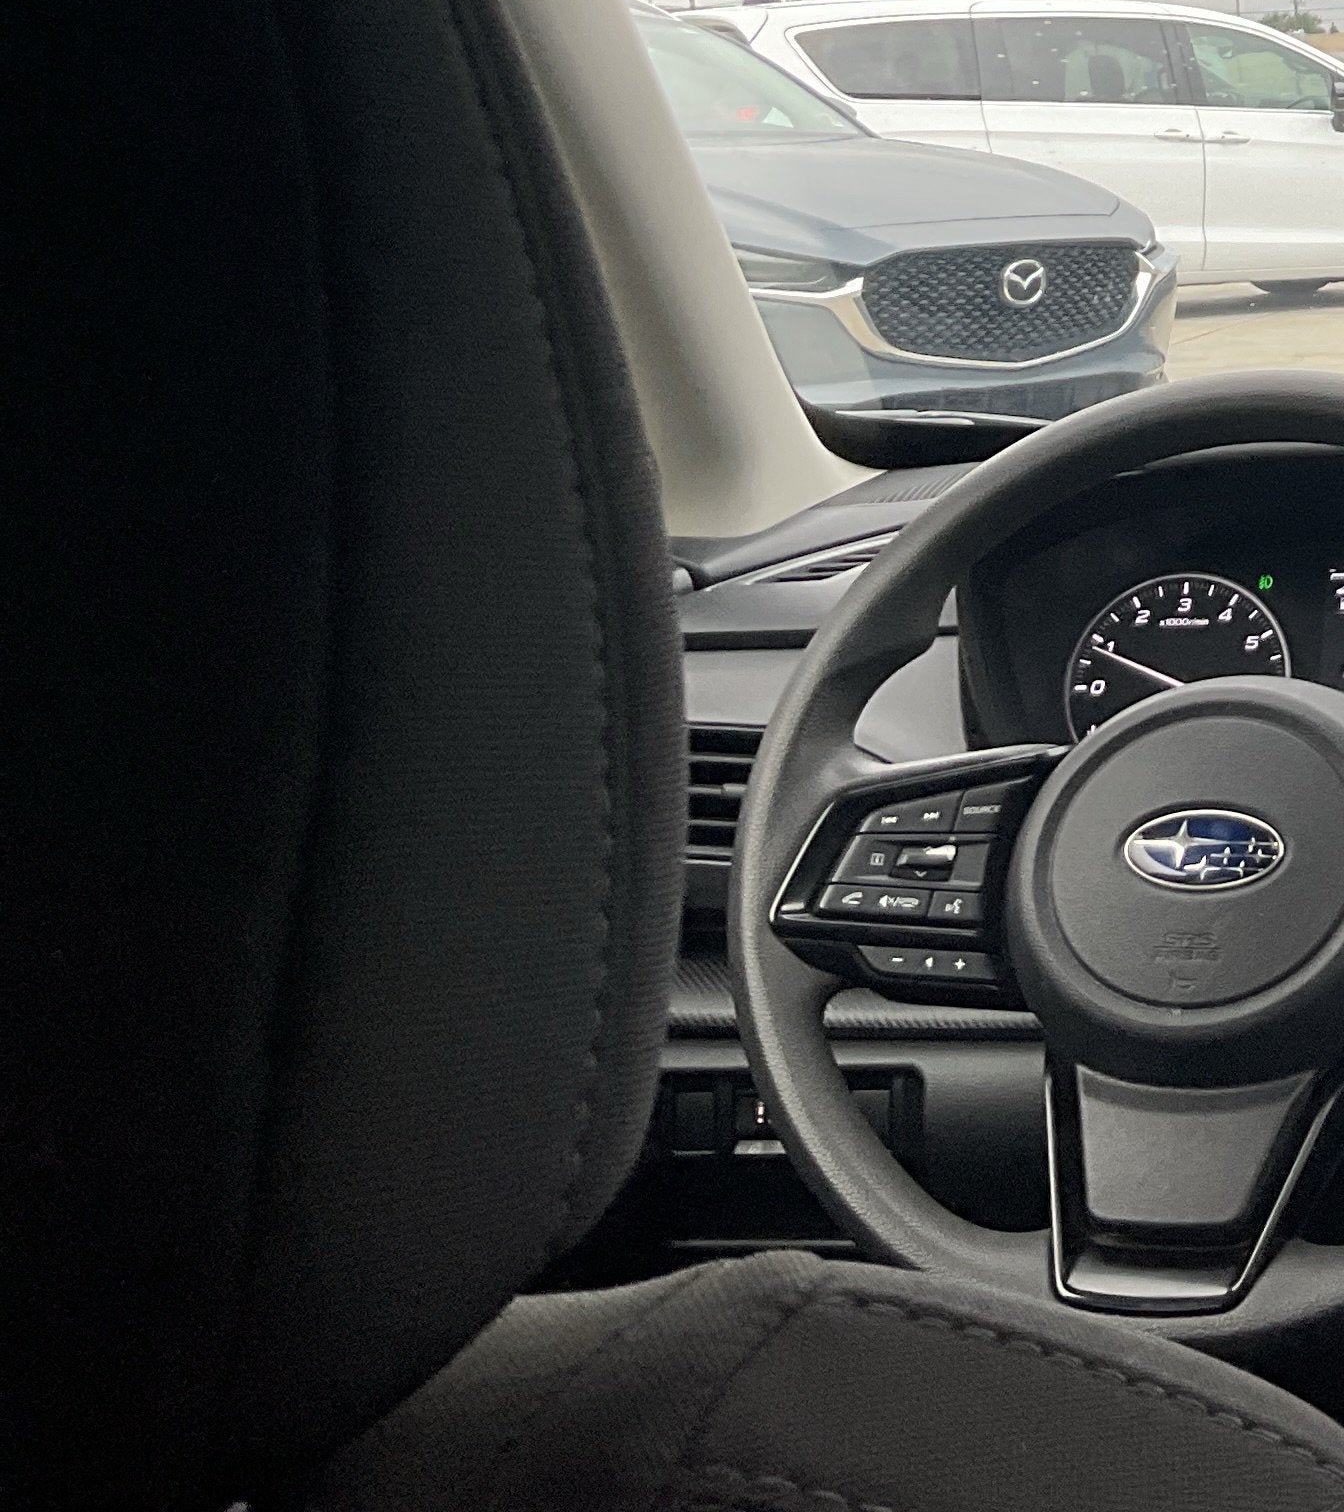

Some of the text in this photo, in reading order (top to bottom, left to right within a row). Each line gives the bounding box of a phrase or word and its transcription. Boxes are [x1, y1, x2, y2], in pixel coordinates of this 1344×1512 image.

[1177, 597, 1193, 613] 3
[1134, 609, 1151, 625] 2
[1218, 607, 1233, 623] 4
[1105, 640, 1115, 653] 1
[1244, 635, 1260, 651] 5
[1089, 679, 1106, 696] 0
